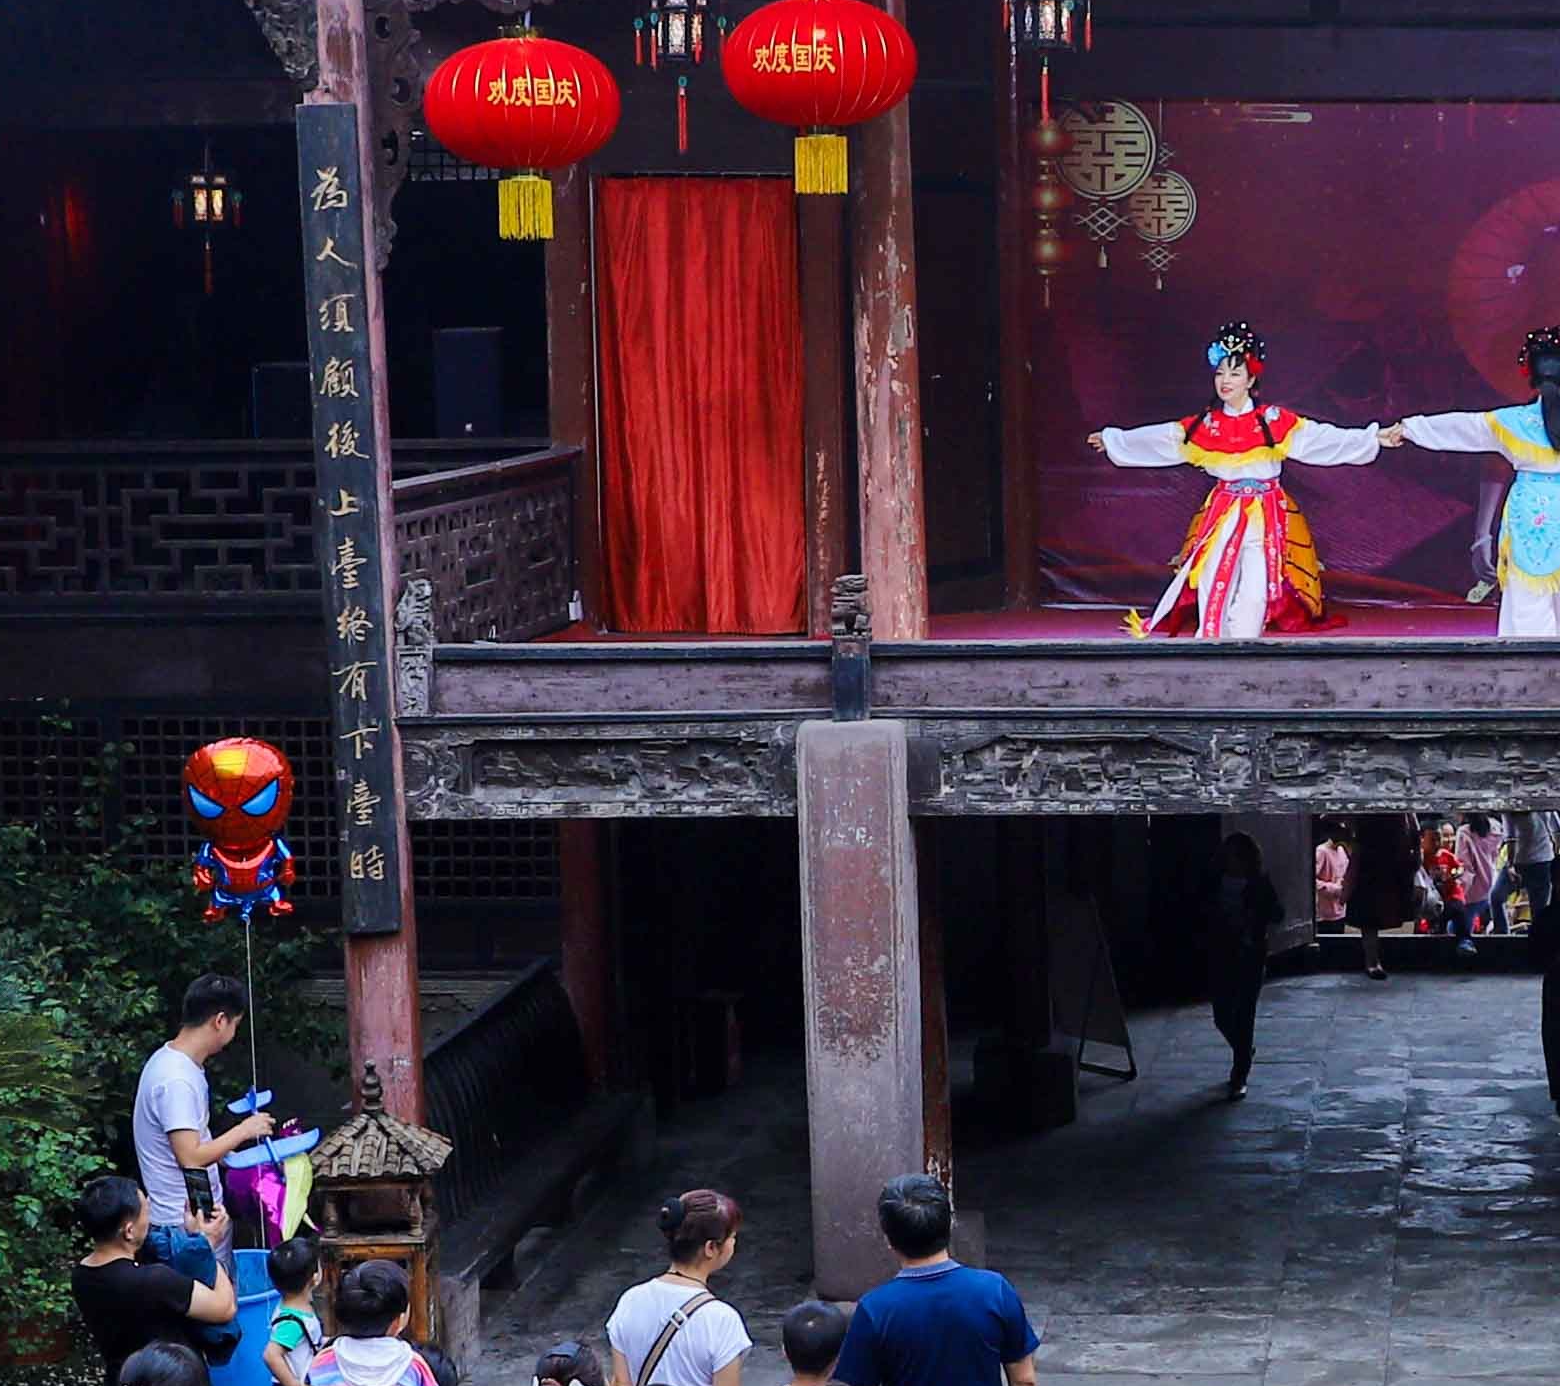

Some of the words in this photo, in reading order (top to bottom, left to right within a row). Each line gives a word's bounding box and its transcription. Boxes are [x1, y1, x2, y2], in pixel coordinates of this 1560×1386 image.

[752, 42, 836, 74] 欢度国庆
[486, 76, 577, 108] 欢度国庆
